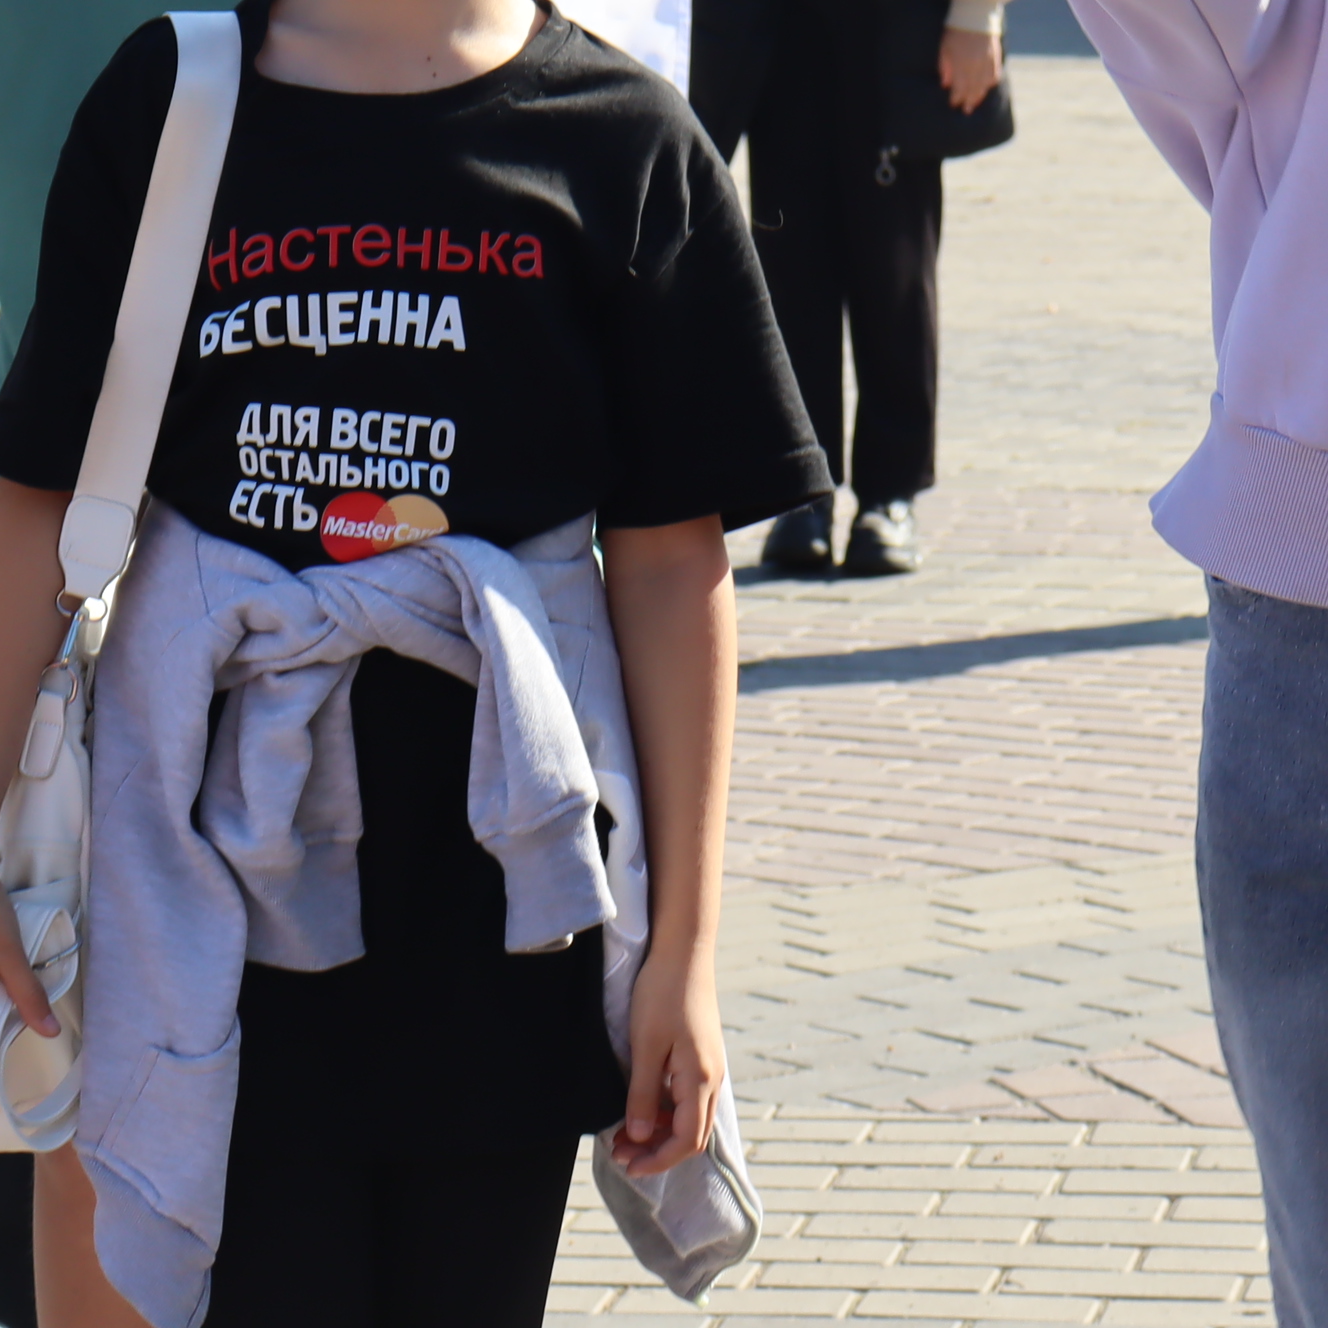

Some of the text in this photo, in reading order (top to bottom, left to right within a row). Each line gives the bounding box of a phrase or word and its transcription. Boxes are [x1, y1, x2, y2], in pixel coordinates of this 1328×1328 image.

[208, 223, 544, 291] Настенька
[199, 289, 466, 358] БЕСЦЕННА
[236, 402, 456, 460] ДЛЯ ВСЕГО
[238, 445, 450, 496] ОСТАЛЬНОГО
[228, 479, 318, 532] ЕСТЬ
